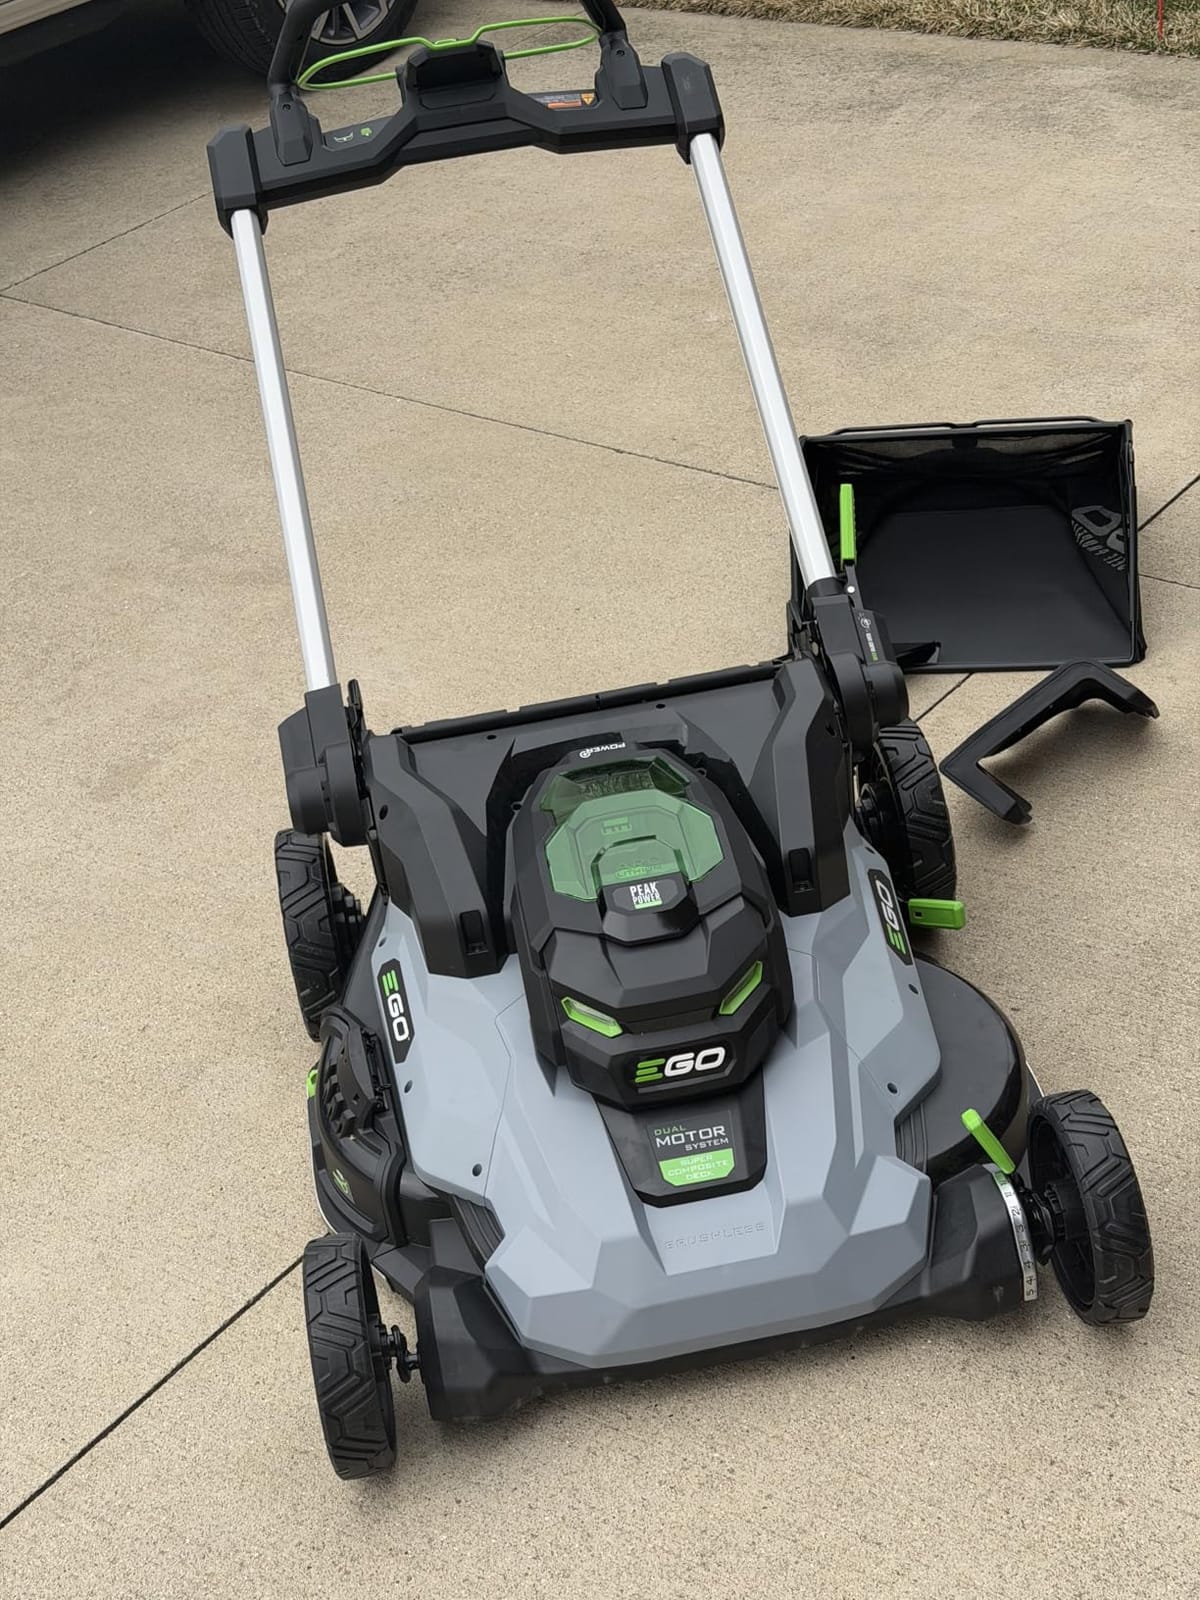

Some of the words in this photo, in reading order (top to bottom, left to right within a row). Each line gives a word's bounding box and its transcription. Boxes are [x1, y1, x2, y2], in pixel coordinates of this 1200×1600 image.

[629, 881, 658, 897] PEAK
[632, 892, 661, 905] POWER
[876, 880, 906, 954] EGO
[382, 970, 409, 1041] EGO
[635, 1047, 726, 1083] EGO
[654, 1125, 686, 1136] DUAL
[655, 1125, 726, 1148] MOTOR
[685, 1138, 729, 1151] SYSTEM
